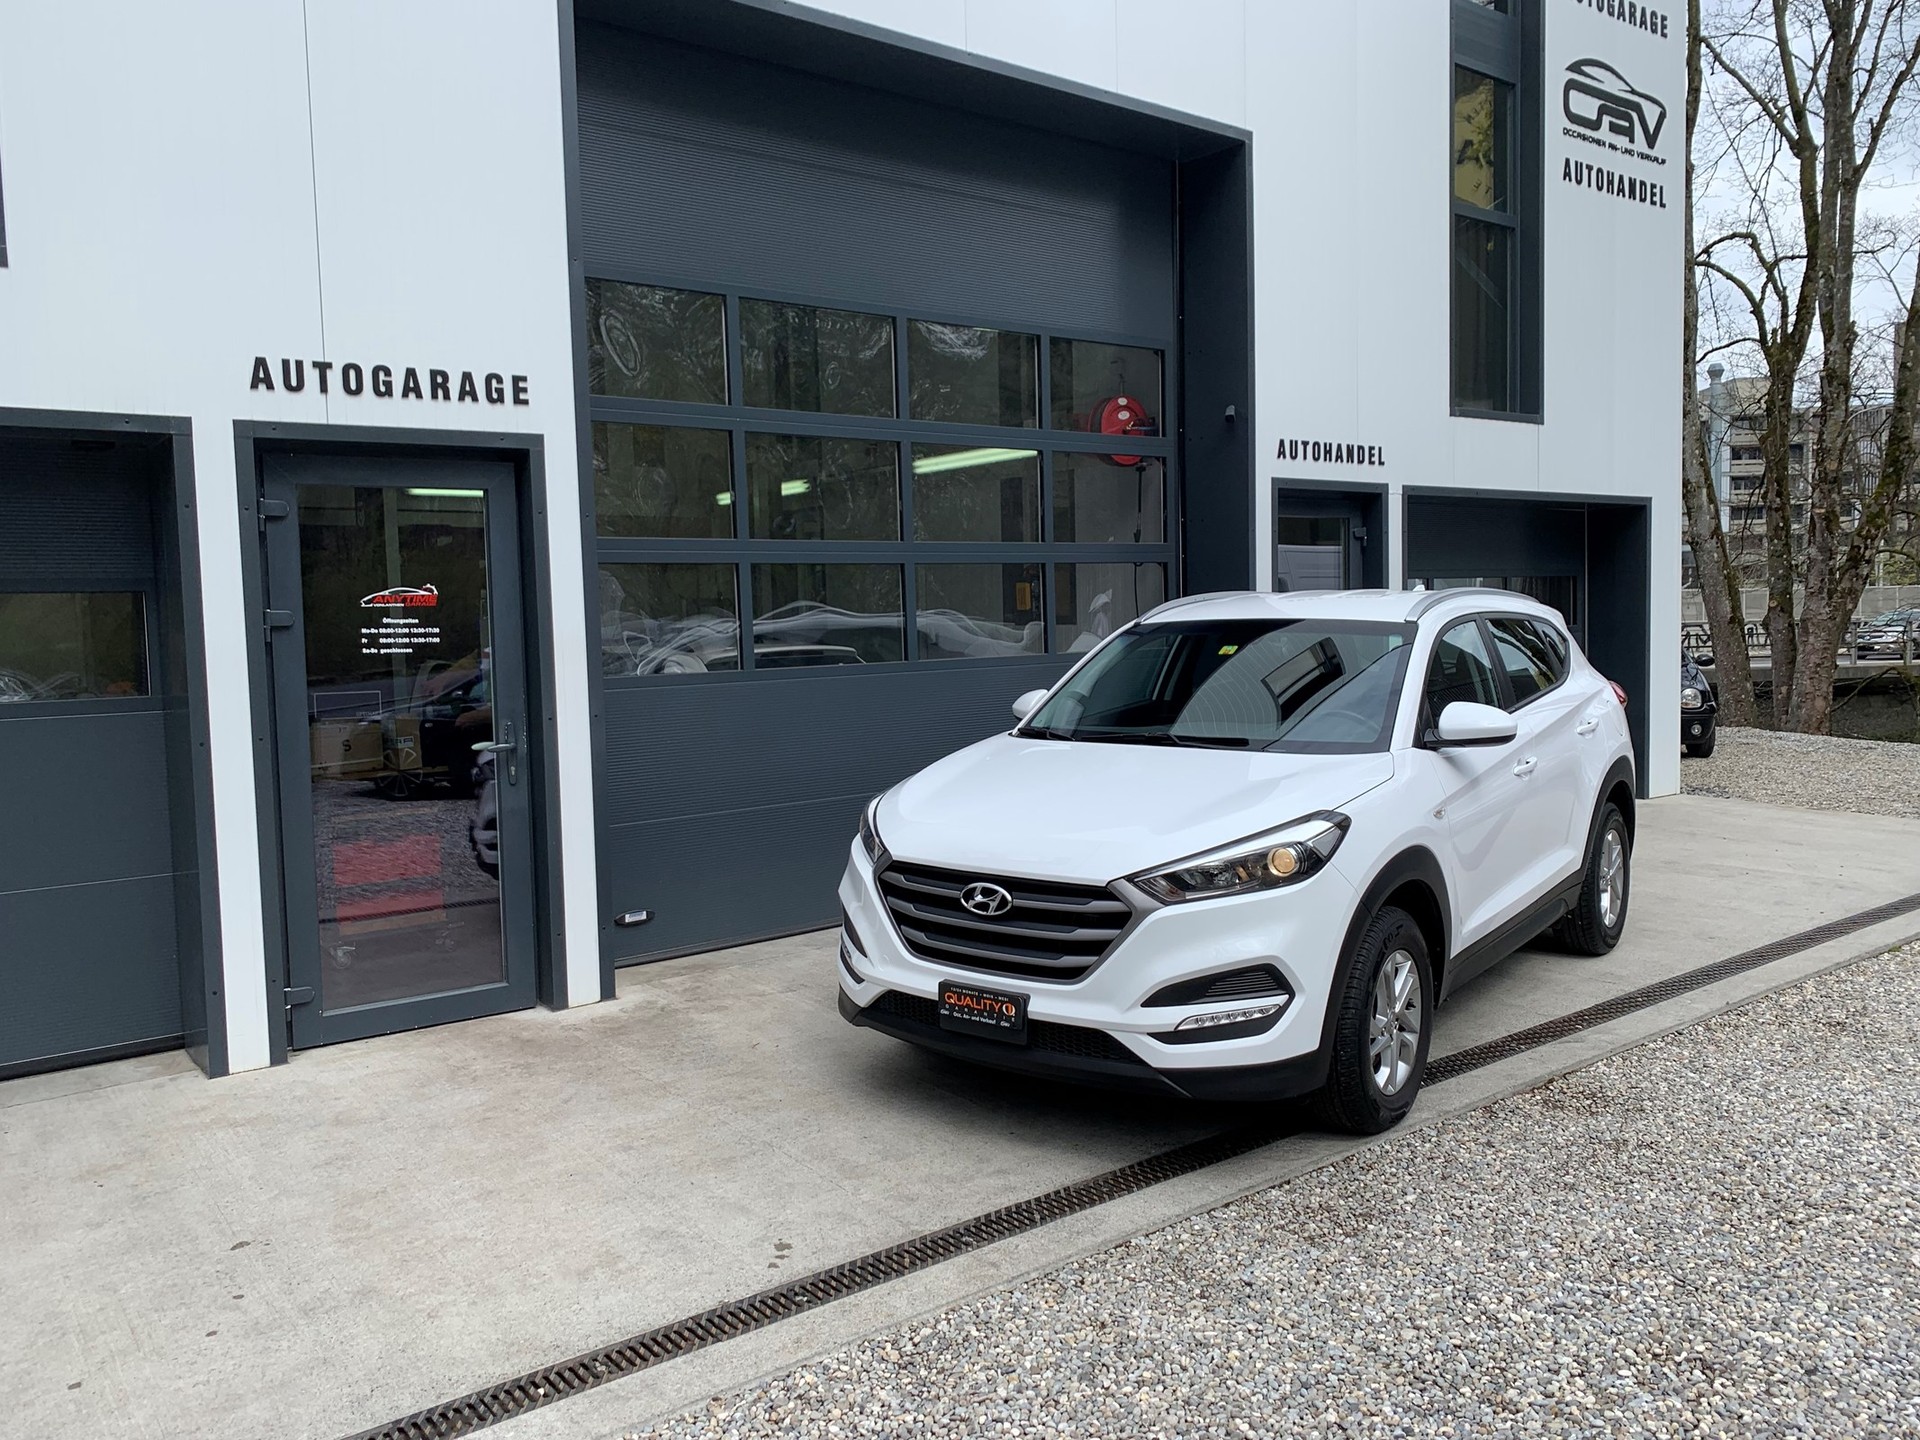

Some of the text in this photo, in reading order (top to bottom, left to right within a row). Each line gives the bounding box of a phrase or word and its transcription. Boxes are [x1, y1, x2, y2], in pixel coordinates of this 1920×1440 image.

[1570, 0, 1668, 39] GARAGE
[1562, 127, 1606, 147] OCCASIONEN
[1620, 146, 1635, 157] UND
[1636, 151, 1667, 165] VERKAUF
[1562, 157, 1667, 208] AUTOHANDEL
[250, 356, 530, 405] AUTOGARAGE
[1276, 438, 1385, 466] AUTOHANDEL
[373, 594, 438, 603] ANYTIME
[944, 992, 1001, 1013] QUALITY
[945, 1003, 1016, 1022] GARANTIE
[980, 1016, 996, 1024] Verkauf
